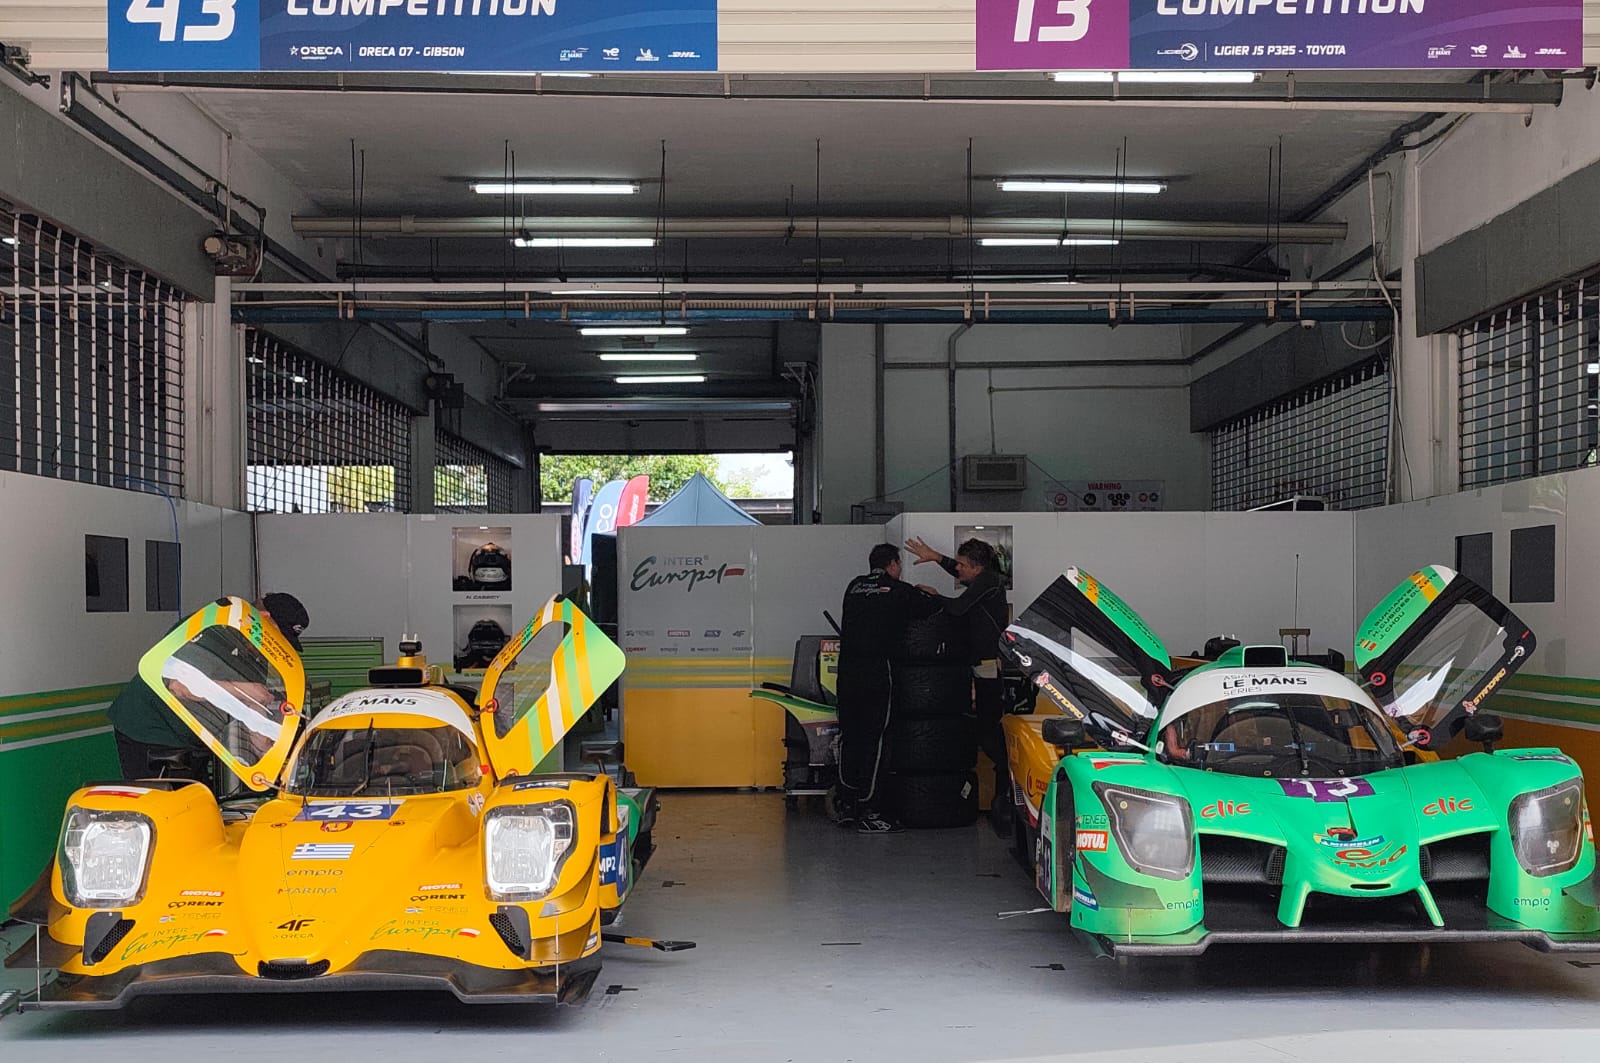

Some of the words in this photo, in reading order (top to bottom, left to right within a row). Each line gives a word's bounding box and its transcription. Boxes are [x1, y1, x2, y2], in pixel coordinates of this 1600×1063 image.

[287, 0, 557, 16] COMPETITION
[1156, 0, 1424, 15] COMPETITION
[126, 0, 236, 41] 43
[1013, 0, 1091, 42] 13
[301, 46, 343, 56] ORECA
[359, 46, 396, 57] ORECA
[399, 46, 414, 57] 07
[423, 46, 465, 57] GIBSON
[1214, 45, 1249, 56] LIGIER
[1267, 45, 1297, 56] P325
[1306, 45, 1347, 56] TOYOTA
[1088, 482, 1122, 491] WARNING
[663, 556, 703, 566] INTER
[630, 555, 727, 592] Europol
[1223, 679, 1245, 689] LE
[1252, 677, 1307, 686] MANS
[1223, 687, 1262, 697] SERIES
[331, 702, 354, 713] LE
[359, 697, 418, 706] MANS
[1299, 778, 1359, 797] 13
[310, 805, 384, 818] 43
[1201, 800, 1251, 818] clic
[1423, 797, 1474, 816] clic
[1077, 832, 1106, 849] MOTUL
[1330, 838, 1380, 848] MICHELIN
[599, 855, 616, 873] MP2
[410, 894, 467, 902] CORENT
[1513, 897, 1551, 908] emplo
[1167, 899, 1200, 911] emplo
[277, 919, 316, 931] 4F
